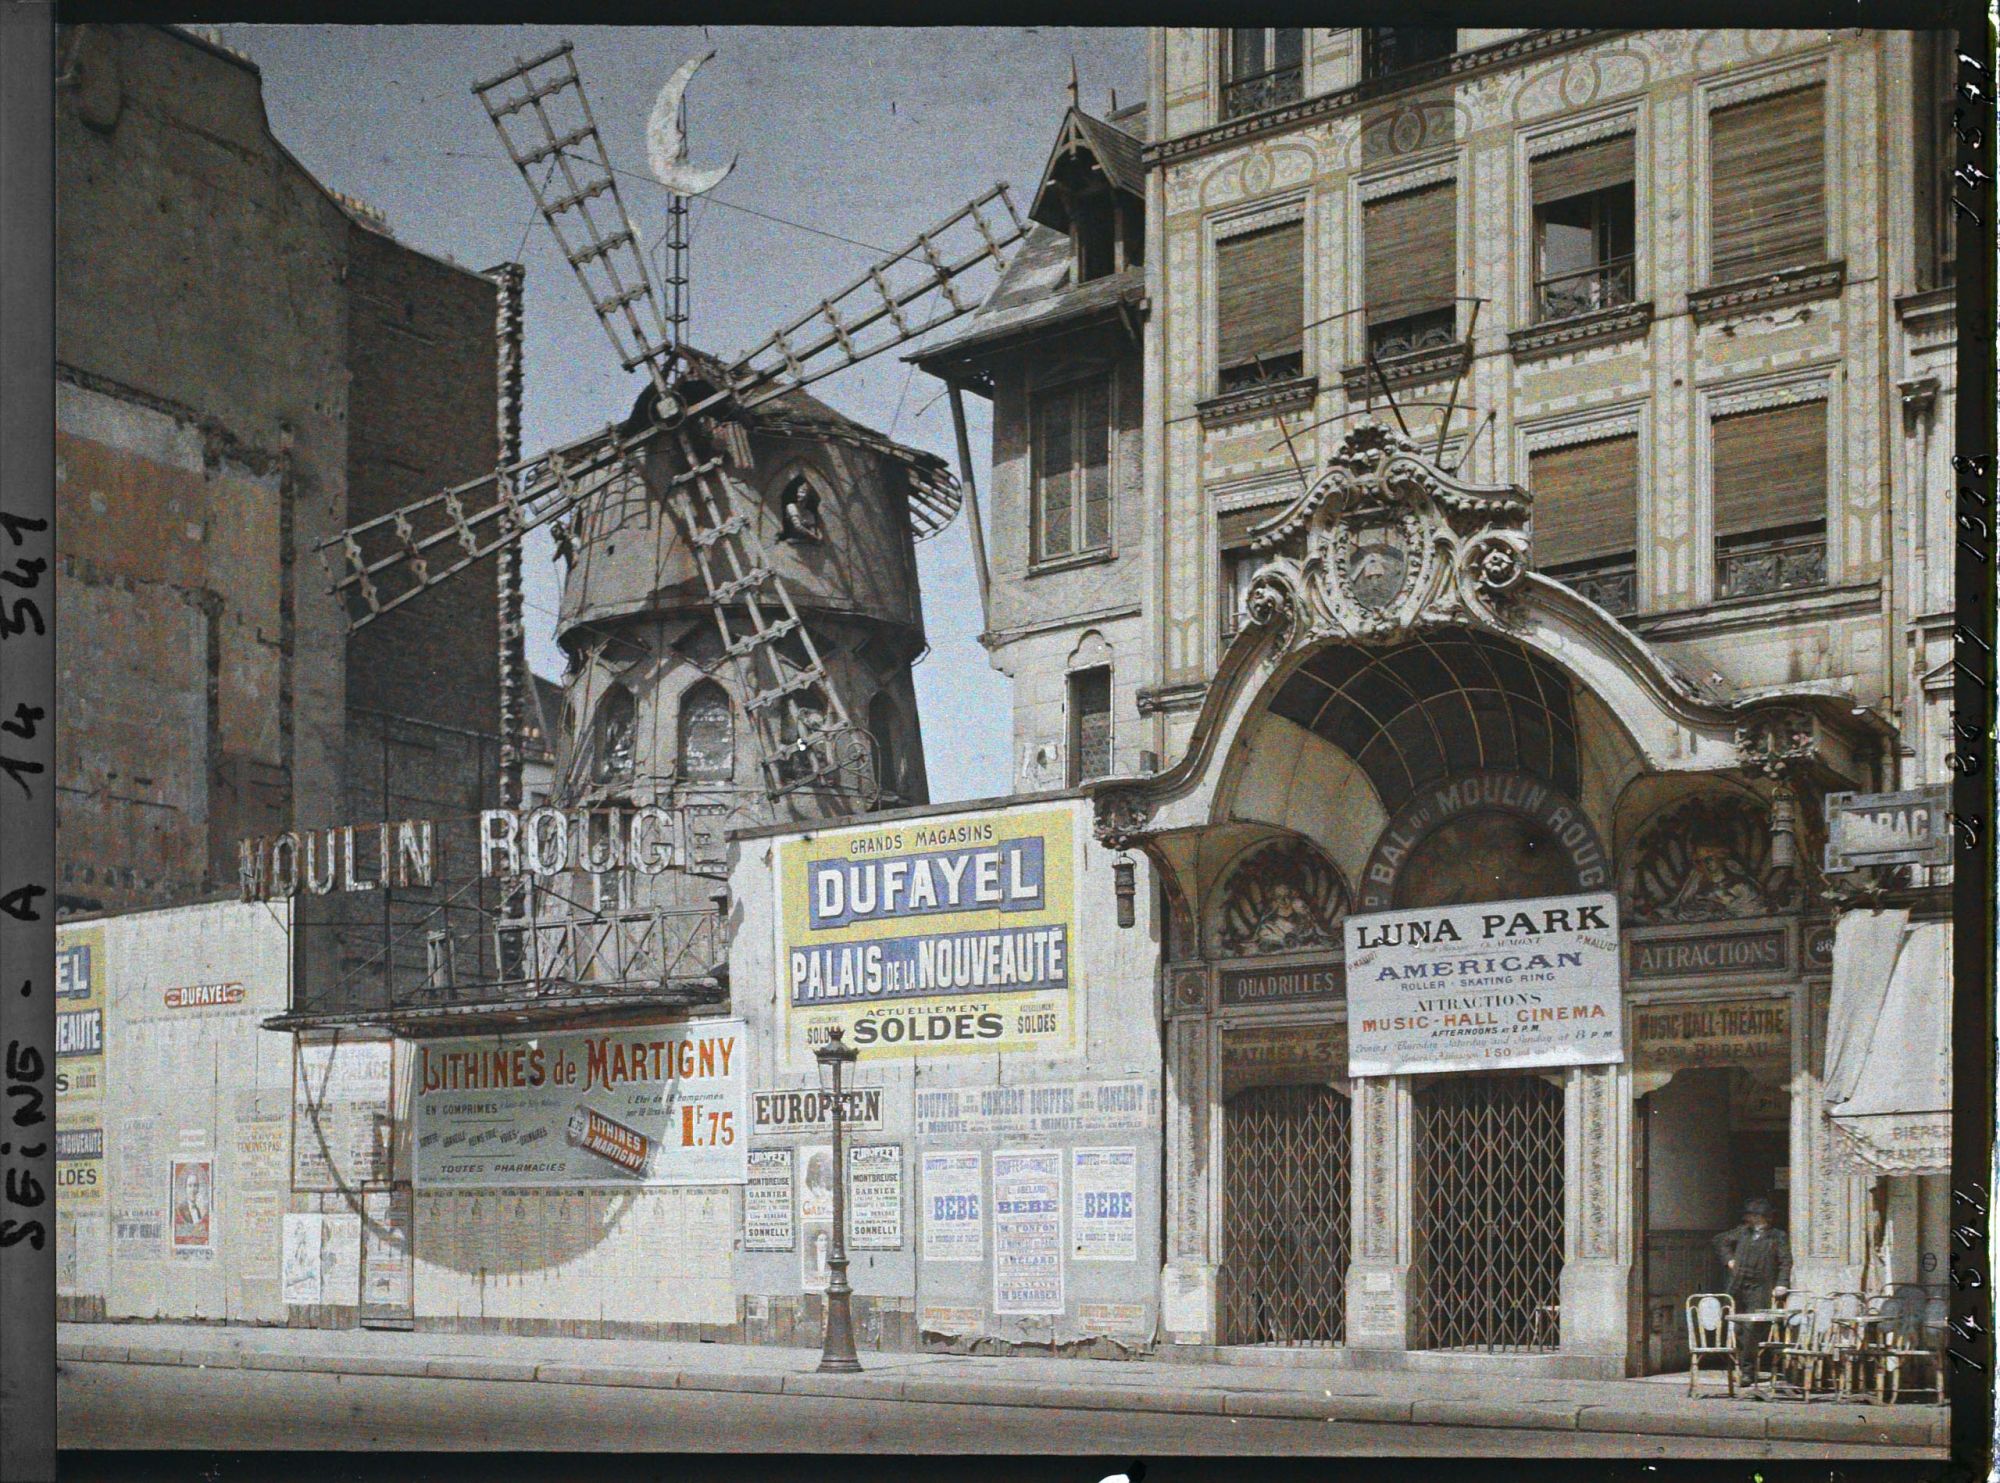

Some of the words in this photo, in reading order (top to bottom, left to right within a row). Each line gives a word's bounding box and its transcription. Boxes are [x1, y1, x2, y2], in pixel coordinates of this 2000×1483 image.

[850, 835, 903, 855] GRANDS
[915, 824, 993, 847] MAGASINS
[1435, 774, 1547, 816] MOULIN
[1546, 805, 1606, 888] ROUG
[239, 818, 433, 902] MOULIN
[480, 804, 728, 878] ROUGE
[817, 849, 1038, 919] DUFAYEL
[1356, 918, 1462, 950] LUNA
[1481, 905, 1610, 939] PARK
[1374, 951, 1583, 982] AMERICAN
[1639, 938, 1778, 970] ATTRACTIONS
[791, 945, 883, 1000] PALAIS
[1237, 972, 1335, 999] QUADRILLES
[1400, 980, 1446, 991] ROLLER
[1459, 975, 1514, 988] SKATING
[1520, 972, 1556, 983] RING
[180, 984, 228, 1006] DUFAYEL
[1413, 993, 1542, 1013] ATTRACTIONS
[865, 1003, 990, 1017] ACTUELLEMENT
[1516, 1004, 1606, 1023] CINEMA
[852, 1012, 1004, 1044] SOLDES
[1017, 1014, 1056, 1034] SOLDES
[1430, 1026, 1498, 1038] AFTERNOONS
[553, 1049, 577, 1086] de
[581, 1035, 736, 1094] MARTIGNY
[425, 1105, 436, 1116] EN
[1040, 1117, 1083, 1130] MINUTE
[928, 1120, 967, 1133] MINUTE
[591, 1136, 643, 1169] MARTIGNY
[440, 1164, 484, 1174] TOUTES
[494, 1162, 567, 1173] PHARMACIES
